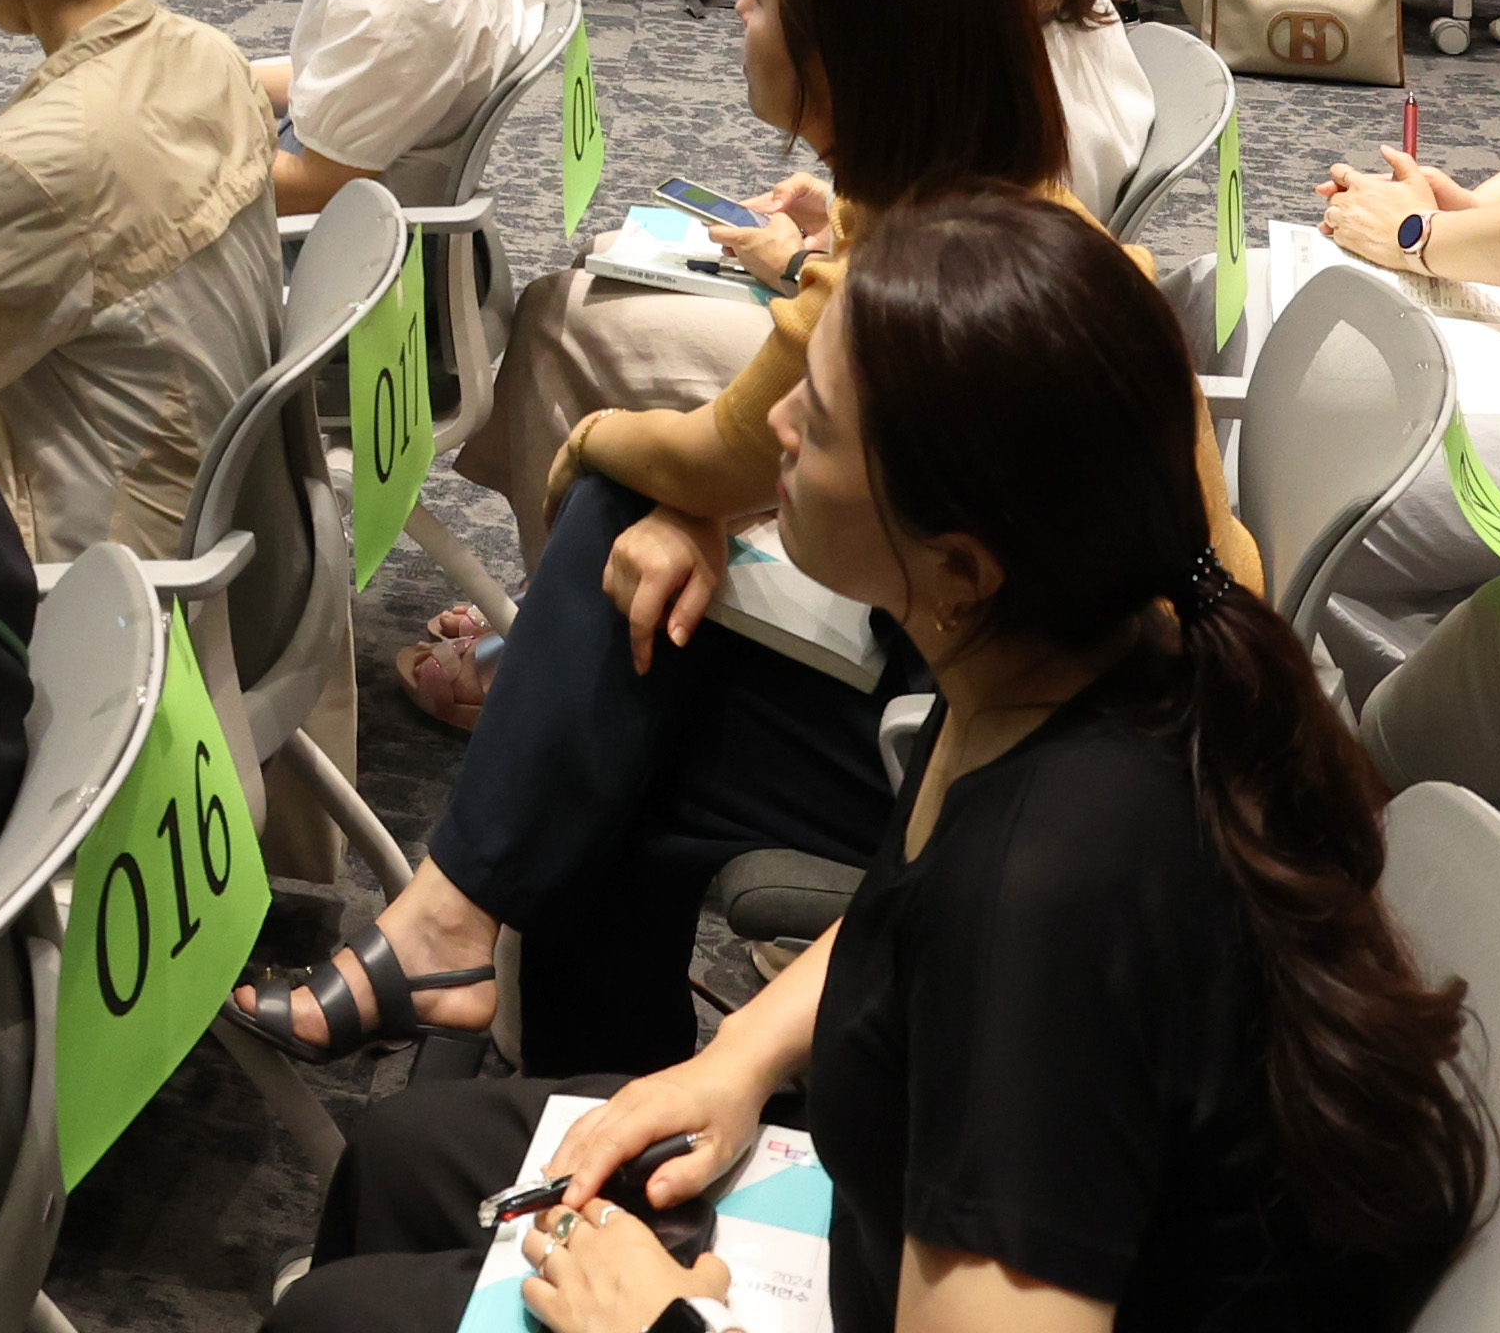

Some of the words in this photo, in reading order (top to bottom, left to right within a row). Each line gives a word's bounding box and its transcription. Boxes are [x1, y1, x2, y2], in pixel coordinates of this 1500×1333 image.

[572, 55, 599, 162] 01
[374, 311, 419, 483] 017
[96, 741, 232, 1017] 016
[771, 1270, 813, 1290] 2024
